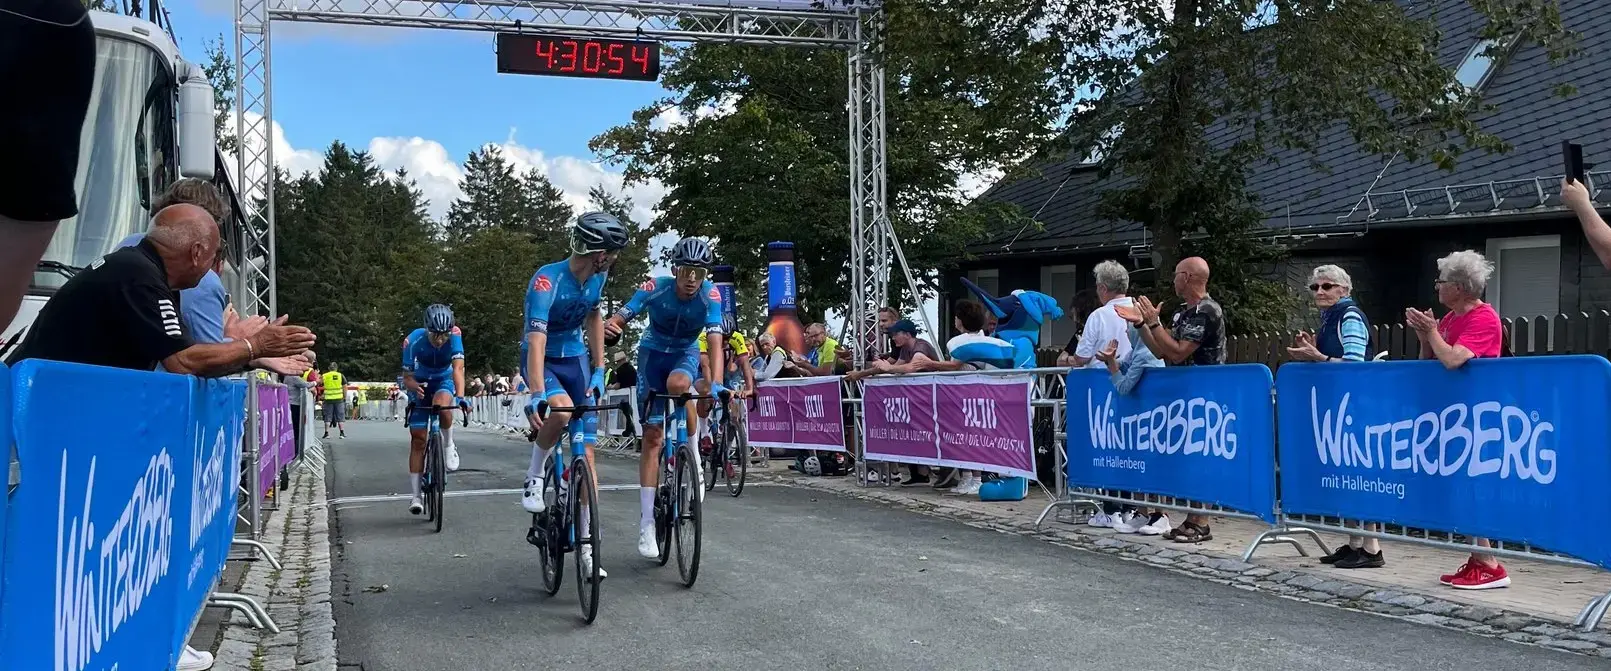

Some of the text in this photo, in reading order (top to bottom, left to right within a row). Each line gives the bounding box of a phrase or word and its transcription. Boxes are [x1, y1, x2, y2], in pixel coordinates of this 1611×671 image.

[536, 40, 649, 75] 4:30:54
[1093, 456, 1146, 473] mit Hallenberg
[1321, 474, 1405, 499] mit Hallenberg
